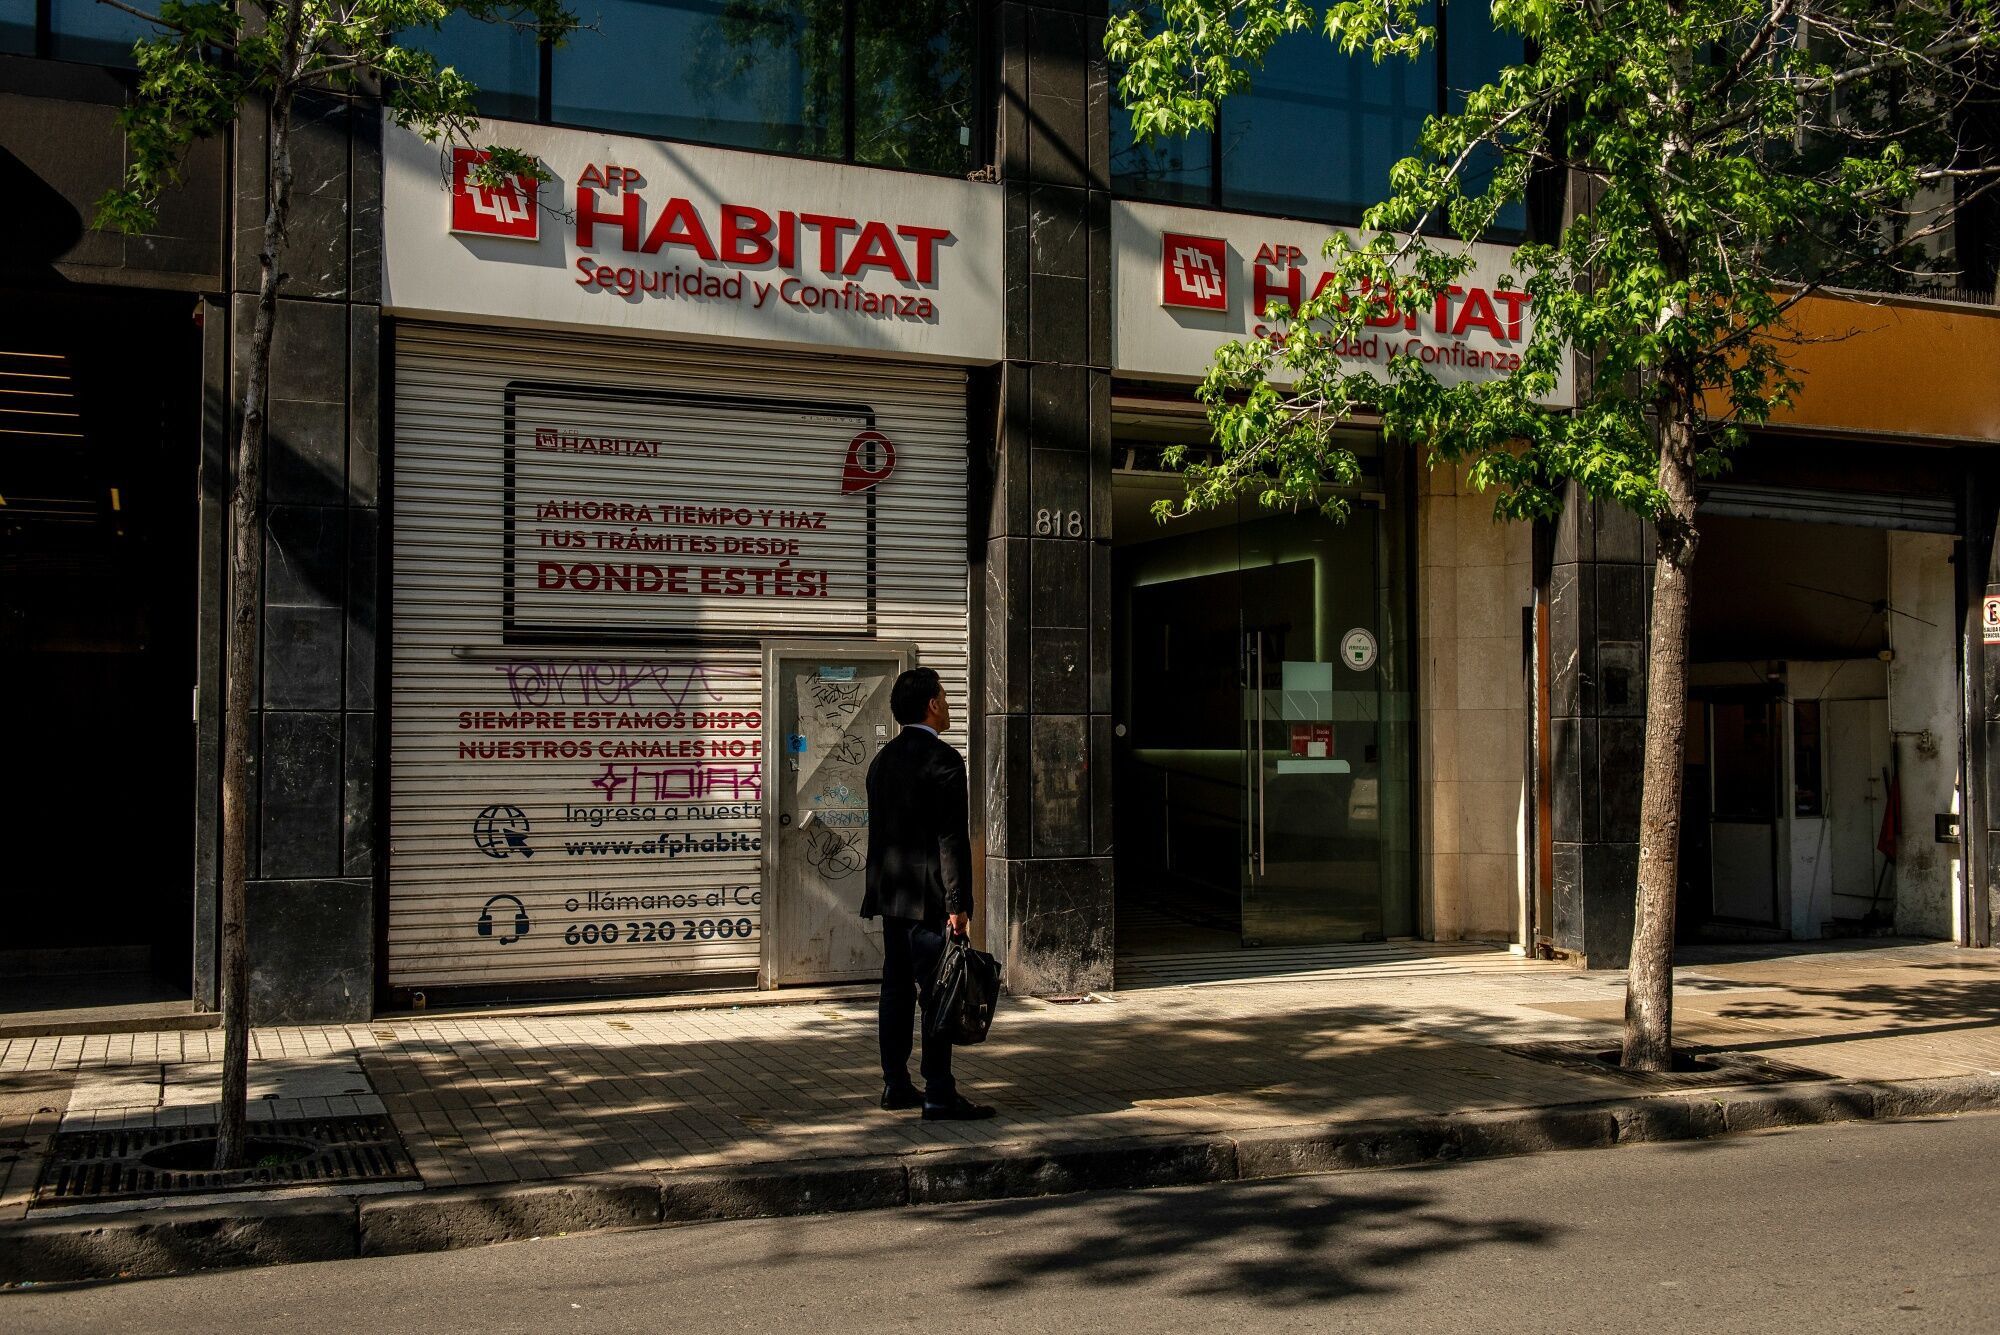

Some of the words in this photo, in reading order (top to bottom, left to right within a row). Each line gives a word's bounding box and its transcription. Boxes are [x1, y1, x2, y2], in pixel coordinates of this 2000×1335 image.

[577, 163, 640, 190] AFP
[576, 187, 950, 283] HABITAT
[1254, 243, 1300, 267] AFP
[576, 257, 742, 299] Seguridad
[753, 280, 771, 308] y
[780, 277, 932, 318] Confianza
[1405, 339, 1520, 371] Confianza
[562, 437, 662, 457] HABITAT
[537, 500, 653, 522] ¡AHORRA
[659, 505, 752, 526] TIEMPO
[758, 509, 774, 527] Y
[780, 510, 827, 529] HAZ
[1036, 508, 1082, 537] 818
[536, 529, 586, 548] TUS
[591, 527, 717, 552] TRÁMITES
[724, 536, 799, 556] DESDE
[538, 560, 688, 592] DONDE
[701, 559, 828, 597] ESTÉS!
[1990, 604, 1997, 621] E
[459, 711, 566, 729] SIEMPRE
[573, 711, 686, 729] ESTAMOS
[693, 711, 762, 729] DISPO
[459, 740, 592, 759] NUESTROS
[599, 740, 705, 758] CANALES
[711, 739, 746, 757] NO
[566, 804, 656, 828] Ingresa
[664, 807, 678, 820] a
[565, 898, 579, 912] o
[588, 891, 698, 911] llámanos
[706, 886, 725, 907] al
[565, 923, 619, 945] 600
[626, 921, 676, 942] 220
[683, 918, 752, 941] 2000
